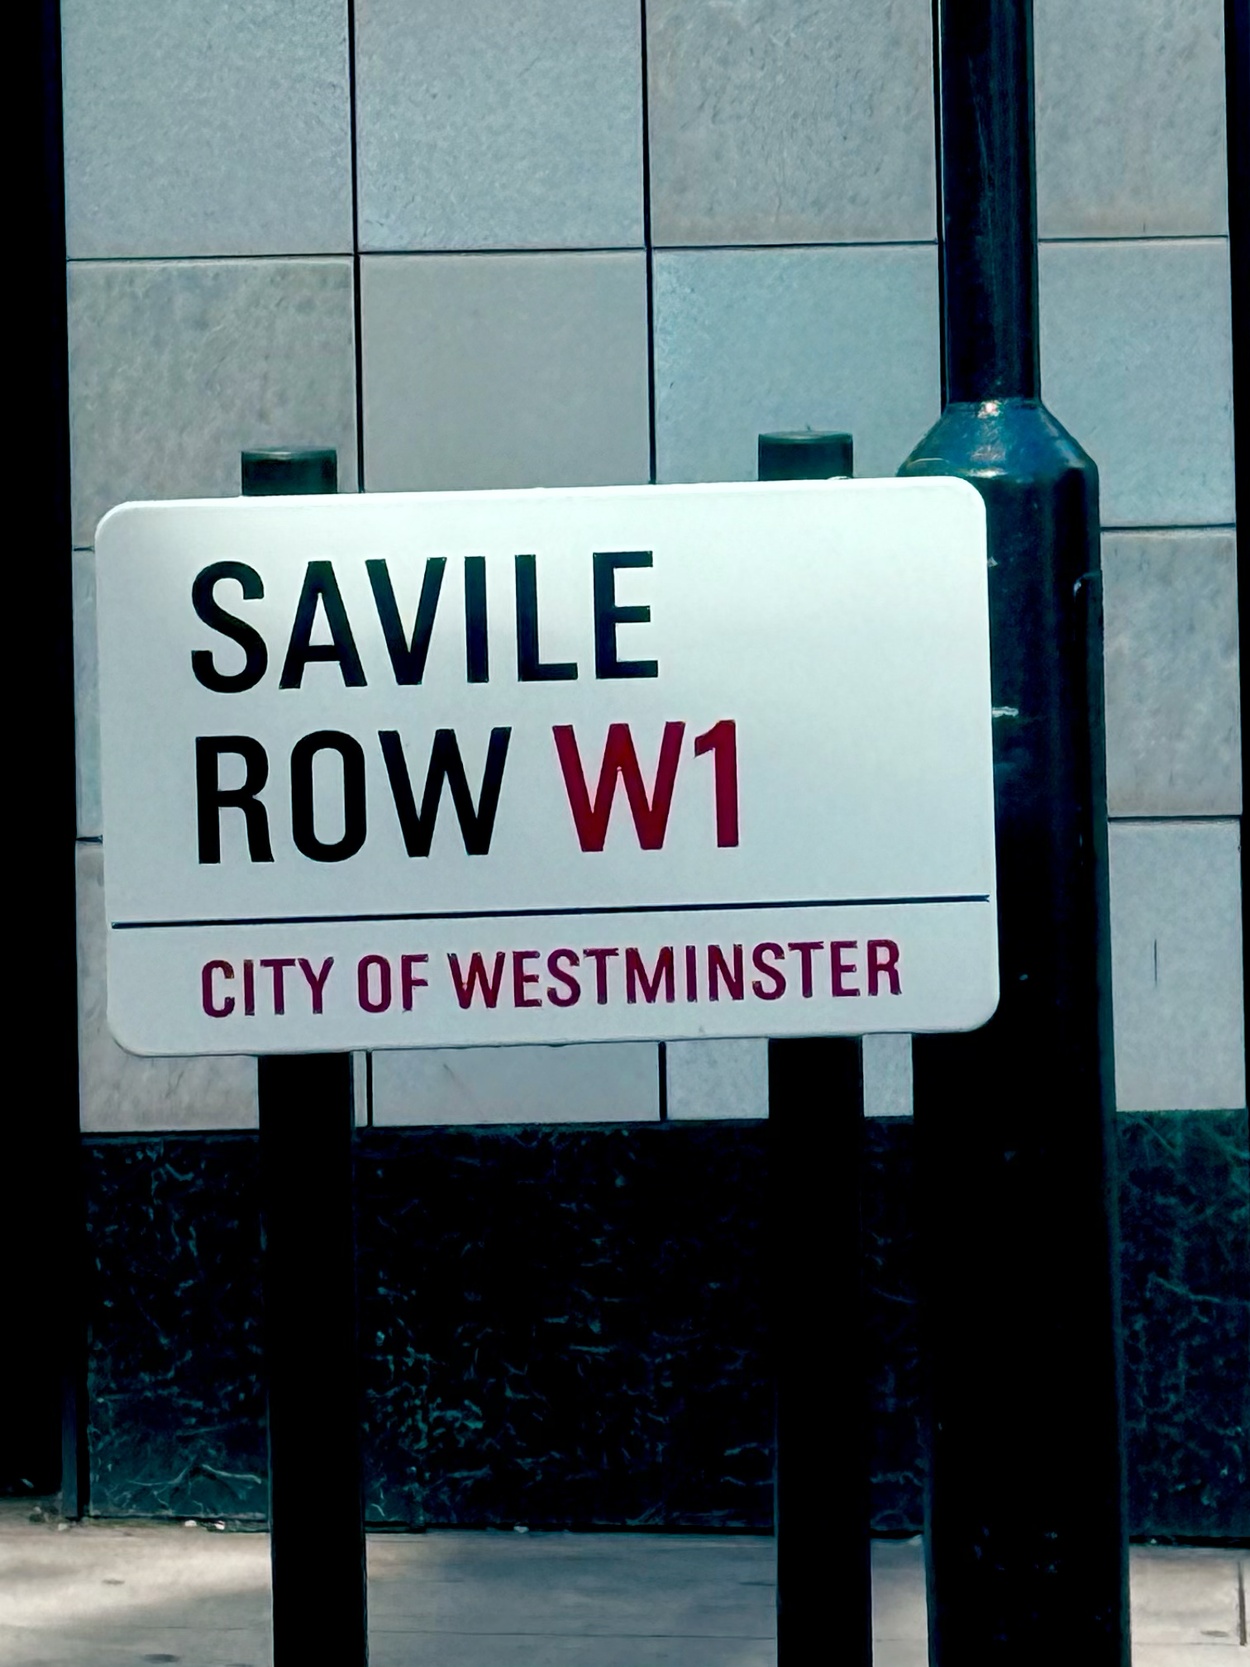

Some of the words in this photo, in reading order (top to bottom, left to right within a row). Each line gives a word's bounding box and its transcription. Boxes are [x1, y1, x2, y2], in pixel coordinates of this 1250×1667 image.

[190, 550, 660, 694] SAVILE
[194, 726, 513, 865] ROW
[551, 719, 740, 853] W1
[201, 955, 336, 1019] CITY
[357, 953, 429, 1015] OF
[446, 938, 903, 1011] WESTMINSTER
